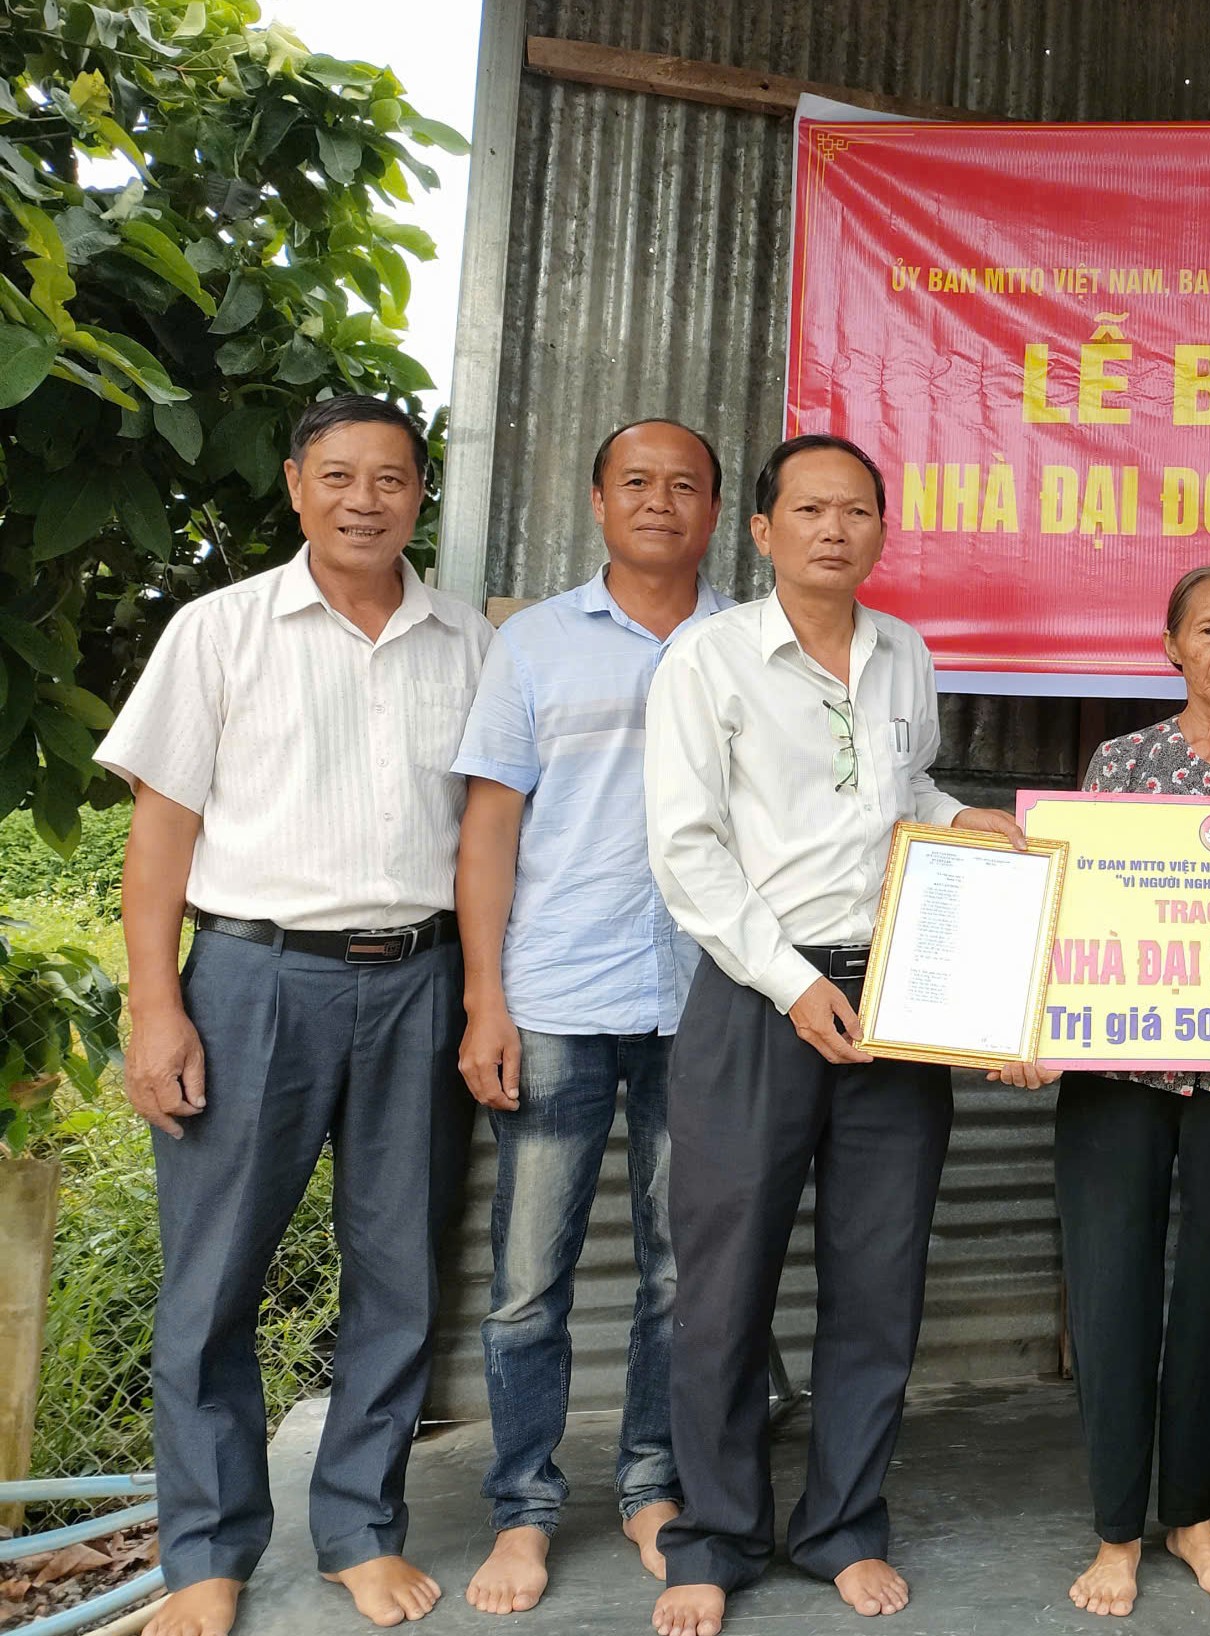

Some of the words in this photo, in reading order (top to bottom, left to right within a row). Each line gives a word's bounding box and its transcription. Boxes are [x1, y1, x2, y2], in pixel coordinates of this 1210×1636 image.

[891, 258, 921, 292] ỦY
[928, 267, 976, 293] BAN
[984, 267, 1044, 296] MTTQ
[1053, 262, 1101, 299] VIỆT
[1109, 268, 1169, 297] NAM,
[1022, 311, 1132, 424] LỄ
[901, 453, 1019, 533] NHÀ
[1039, 465, 1136, 548] ĐẠI
[1077, 856, 1094, 870] ỦY
[1098, 859, 1125, 871] BAN
[1130, 860, 1165, 872] MTTQ
[1170, 859, 1196, 874] VIỆT
[1139, 875, 1180, 888] NGƯỜI
[1048, 930, 1126, 985] NHÀ
[1137, 939, 1201, 994] ĐẠI
[1046, 1006, 1092, 1048] Trị
[1106, 1006, 1162, 1045] giá
